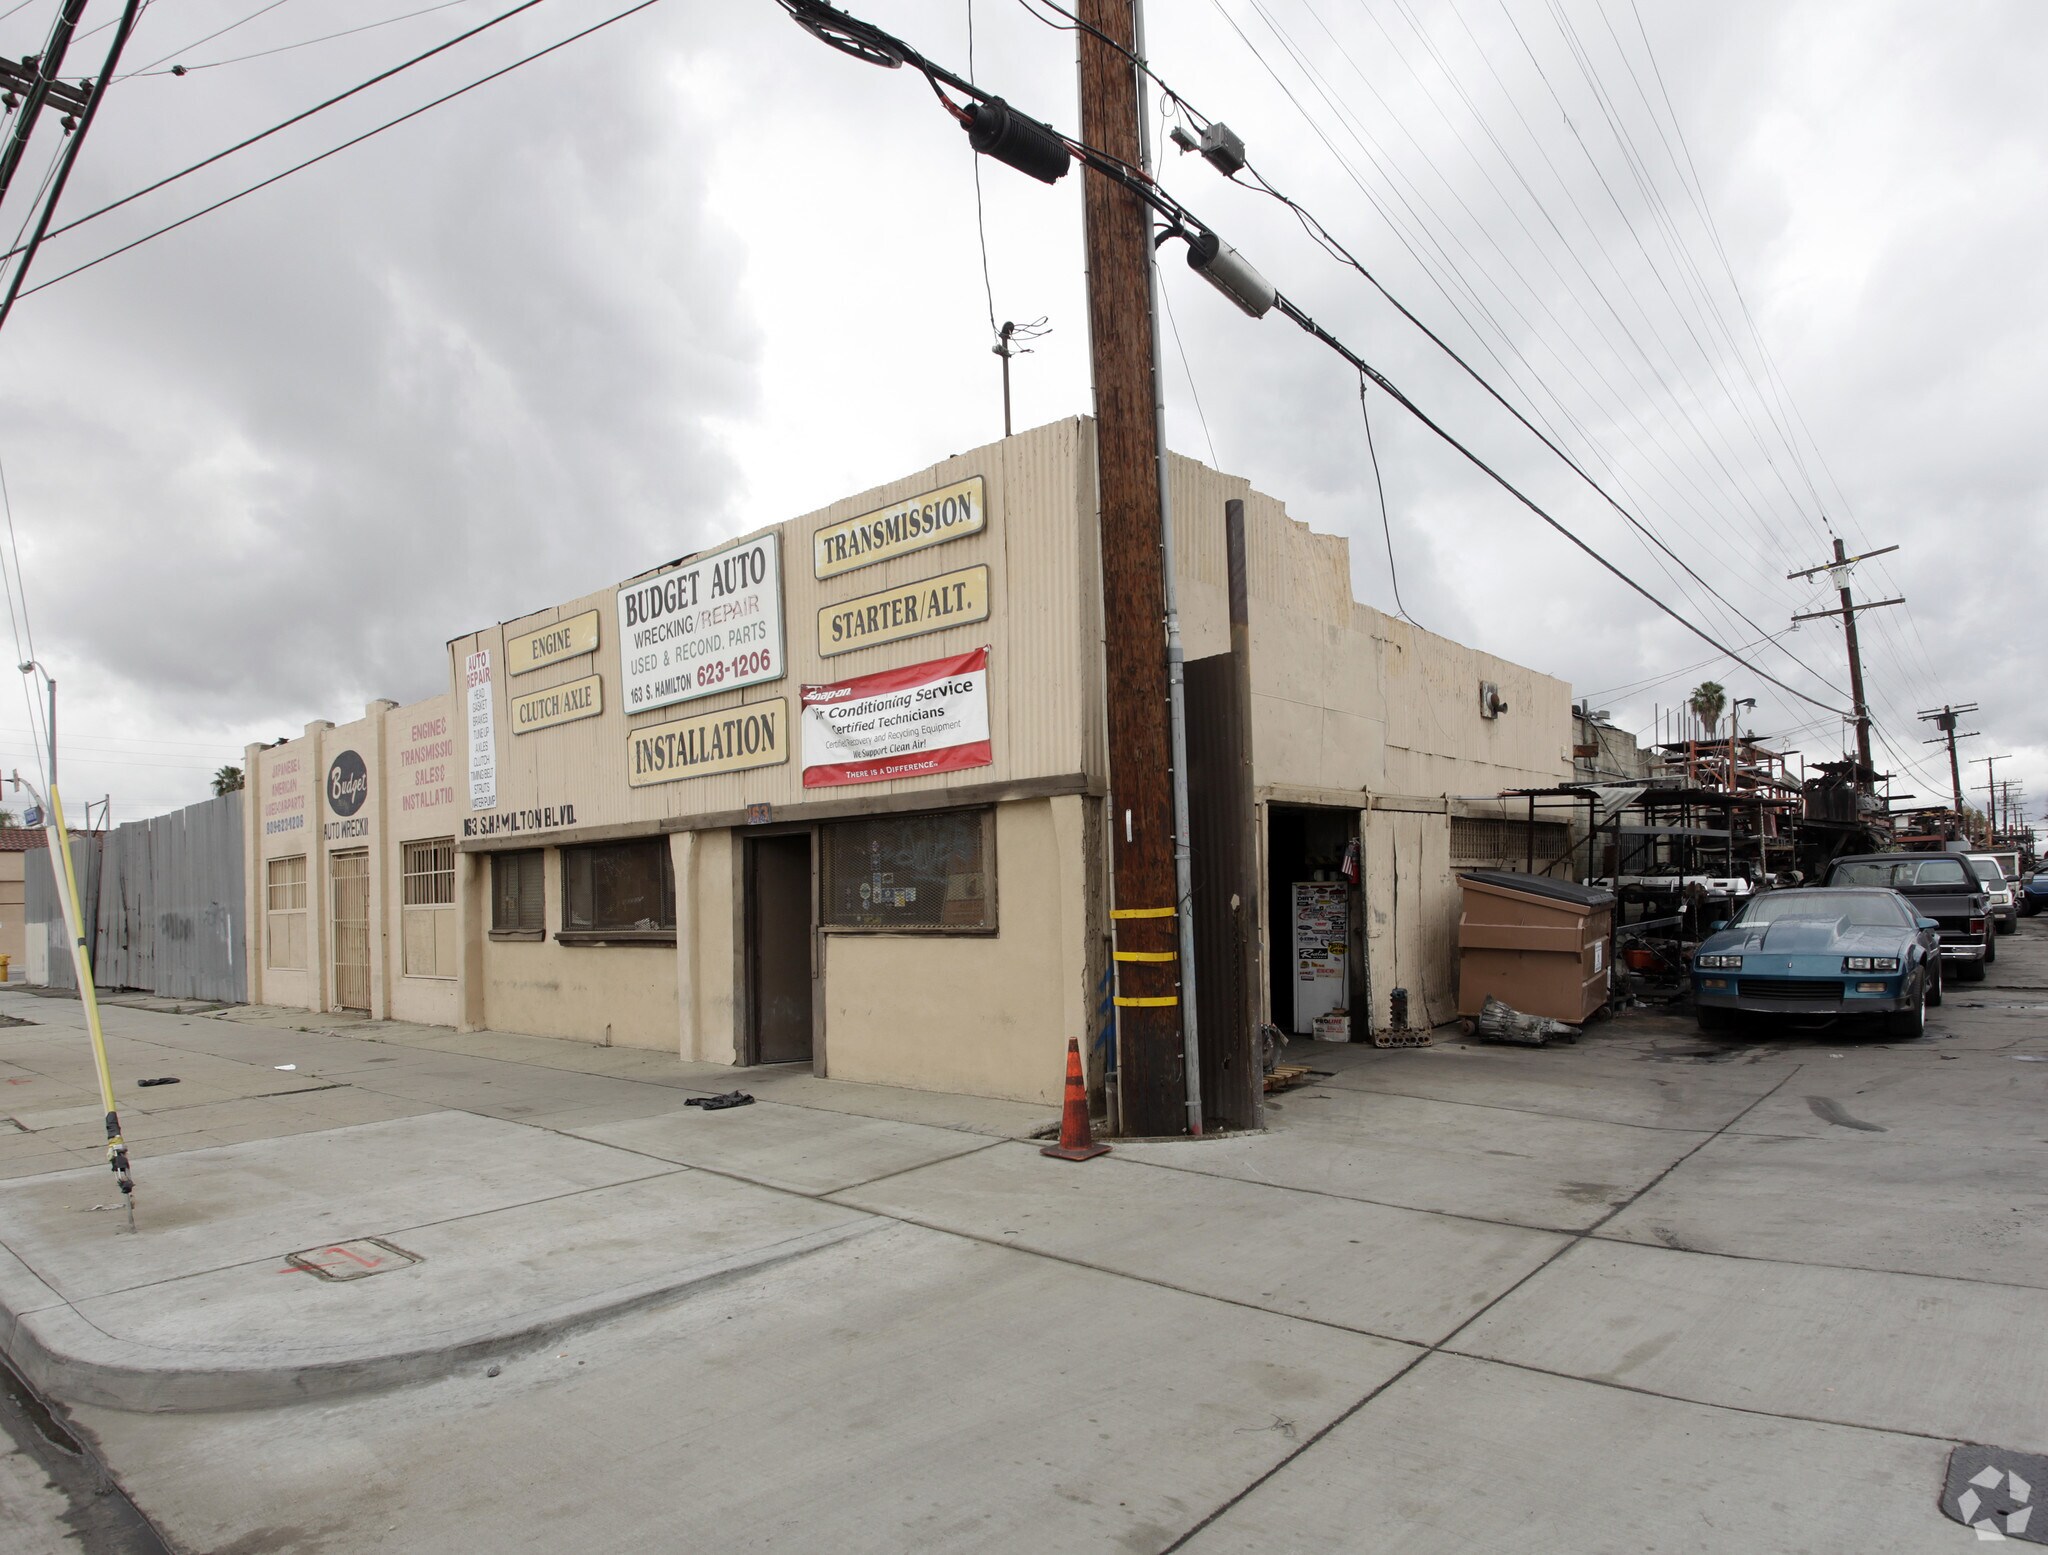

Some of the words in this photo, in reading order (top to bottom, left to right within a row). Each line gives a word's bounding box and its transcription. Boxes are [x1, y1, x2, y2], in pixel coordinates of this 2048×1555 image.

[824, 491, 972, 564] TRANSMISSION
[625, 570, 700, 627] BUDGET
[711, 547, 766, 599] AUTO
[832, 582, 972, 642] STARTER/ALT.
[532, 628, 571, 660] ENGINE
[631, 654, 658, 675] USED
[663, 650, 670, 667] &
[675, 634, 725, 663] RECOND.
[728, 620, 766, 647] PARTS
[469, 652, 486, 672] AUTO
[467, 667, 491, 689] REPAIR
[630, 686, 643, 704] 163
[646, 684, 653, 700] S.
[655, 673, 692, 698] HAMILTON
[697, 648, 771, 687] 623-1206
[472, 699, 488, 713] GASKET
[474, 688, 486, 700] HEAD
[520, 686, 592, 724] CLUTCH/AXLE
[828, 692, 912, 720] Conditioning
[915, 680, 973, 702] Service
[473, 713, 488, 727] BRAKES
[832, 718, 876, 736] Certified
[878, 706, 945, 729] Technicians
[874, 732, 886, 743] and
[888, 727, 919, 741] Recycling
[921, 720, 961, 735] Equipment
[473, 728, 483, 740] TUNE
[484, 726, 489, 738] UP
[635, 712, 775, 775] INSTALLATION
[401, 739, 453, 767] TRANSMISSIO
[475, 741, 488, 752] AXLES
[853, 750, 861, 759] We
[862, 746, 888, 759] Support
[890, 741, 910, 754] Clean
[912, 738, 927, 750] Air!
[474, 755, 490, 767] CLUTCH
[332, 766, 367, 804] Budget
[846, 771, 869, 779] THERE
[402, 787, 454, 811] INSTALLATIO
[474, 782, 490, 795] STRUTS
[324, 822, 340, 840] AUTO
[464, 817, 477, 837] 163
[544, 804, 577, 828] BLVD.
